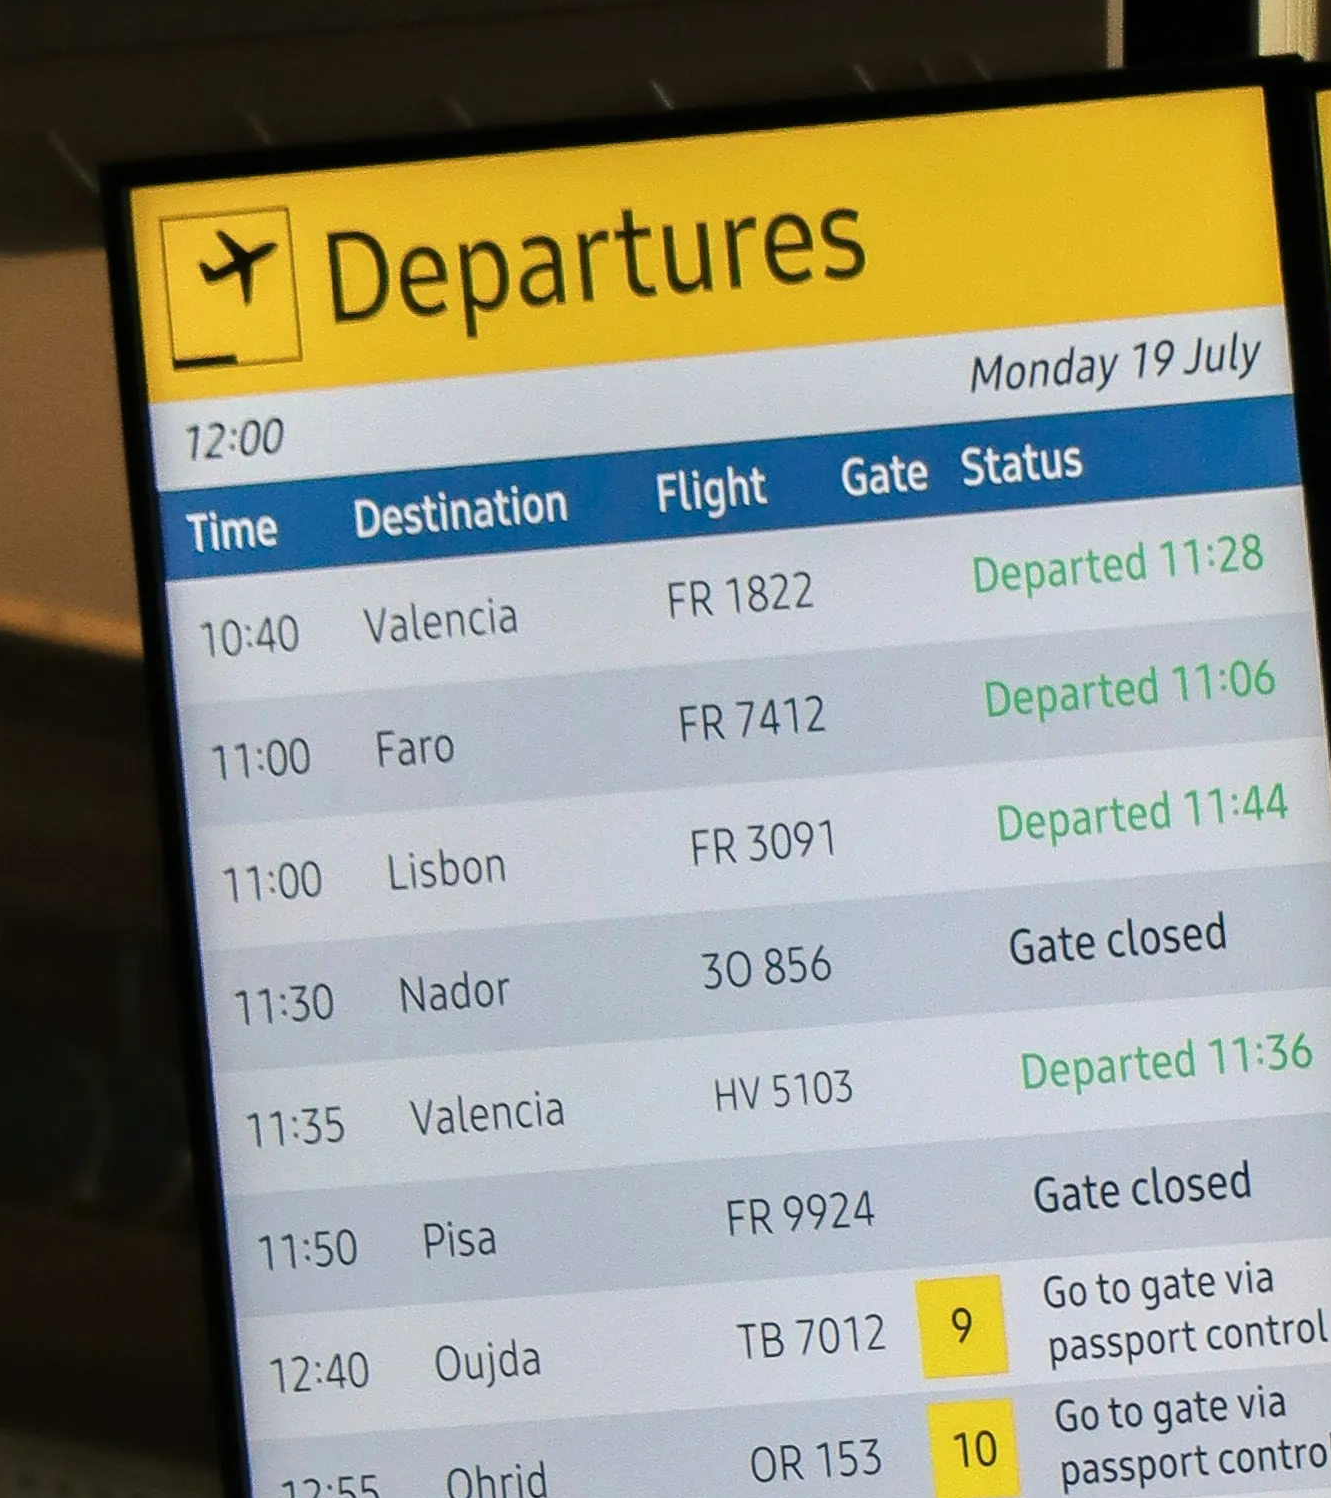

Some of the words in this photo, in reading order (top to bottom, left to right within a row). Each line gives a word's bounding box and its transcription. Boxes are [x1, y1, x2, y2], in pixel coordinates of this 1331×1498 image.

[325, 206, 867, 341] Departures
[969, 344, 1120, 395] Monday
[1132, 338, 1176, 380] 19
[1182, 330, 1263, 381] July
[185, 415, 285, 462] 12:00
[186, 511, 278, 552] Time
[353, 485, 569, 543] Destination
[655, 464, 769, 519] Flight
[841, 455, 929, 497] Gate
[961, 443, 1084, 486] Status
[972, 540, 1148, 600] Departed
[1159, 532, 1266, 578] 11:28
[667, 579, 715, 620] FR
[724, 570, 815, 614] 1822
[199, 613, 300, 658] 10:40
[362, 596, 519, 645] Valencia
[984, 665, 1160, 724] Departed
[1171, 658, 1278, 702] 11:06
[678, 702, 727, 744] FR
[734, 693, 827, 739] 7412
[211, 736, 312, 782] 11:00
[375, 728, 456, 769] Faro
[996, 789, 1173, 849] Departed
[1184, 781, 1290, 827] 11:44
[690, 826, 738, 868] FR
[746, 818, 835, 863] 3091
[222, 859, 323, 904] 11:00
[387, 847, 507, 892] Lisbon
[1008, 925, 1097, 967] Gate
[1106, 909, 1228, 959] closed
[763, 943, 833, 987] 856
[233, 981, 335, 1027] 11:30
[398, 969, 511, 1015] Nador
[1021, 1037, 1197, 1096] Departed
[1207, 1031, 1314, 1075] 11:36
[408, 1089, 566, 1137] Valencia
[714, 1075, 761, 1113] HV
[771, 1068, 854, 1109] 5103
[245, 1104, 346, 1149] 11:35
[1032, 1174, 1122, 1215] Gate
[1130, 1158, 1253, 1208] closed
[726, 1197, 775, 1238] FR
[781, 1189, 877, 1233] 9924
[257, 1227, 359, 1272] 11:50
[422, 1220, 498, 1260] Pisa
[1042, 1274, 1089, 1310] Go
[1094, 1272, 1133, 1306] to
[1139, 1266, 1217, 1312] gate
[1223, 1259, 1275, 1296] via
[735, 1320, 786, 1360] TB
[794, 1312, 887, 1356] 7012
[950, 1306, 974, 1345] 9
[1048, 1320, 1199, 1372] passport
[1205, 1307, 1330, 1352] control
[269, 1350, 370, 1394] 12:40
[434, 1338, 542, 1389] Oujda
[1054, 1397, 1102, 1434] Go
[1106, 1396, 1145, 1430] to
[1152, 1390, 1230, 1436] gate
[1236, 1383, 1288, 1420] via
[749, 1443, 806, 1485] OR
[814, 1437, 883, 1479] 153
[952, 1428, 998, 1469] 10
[1060, 1444, 1211, 1497] passport
